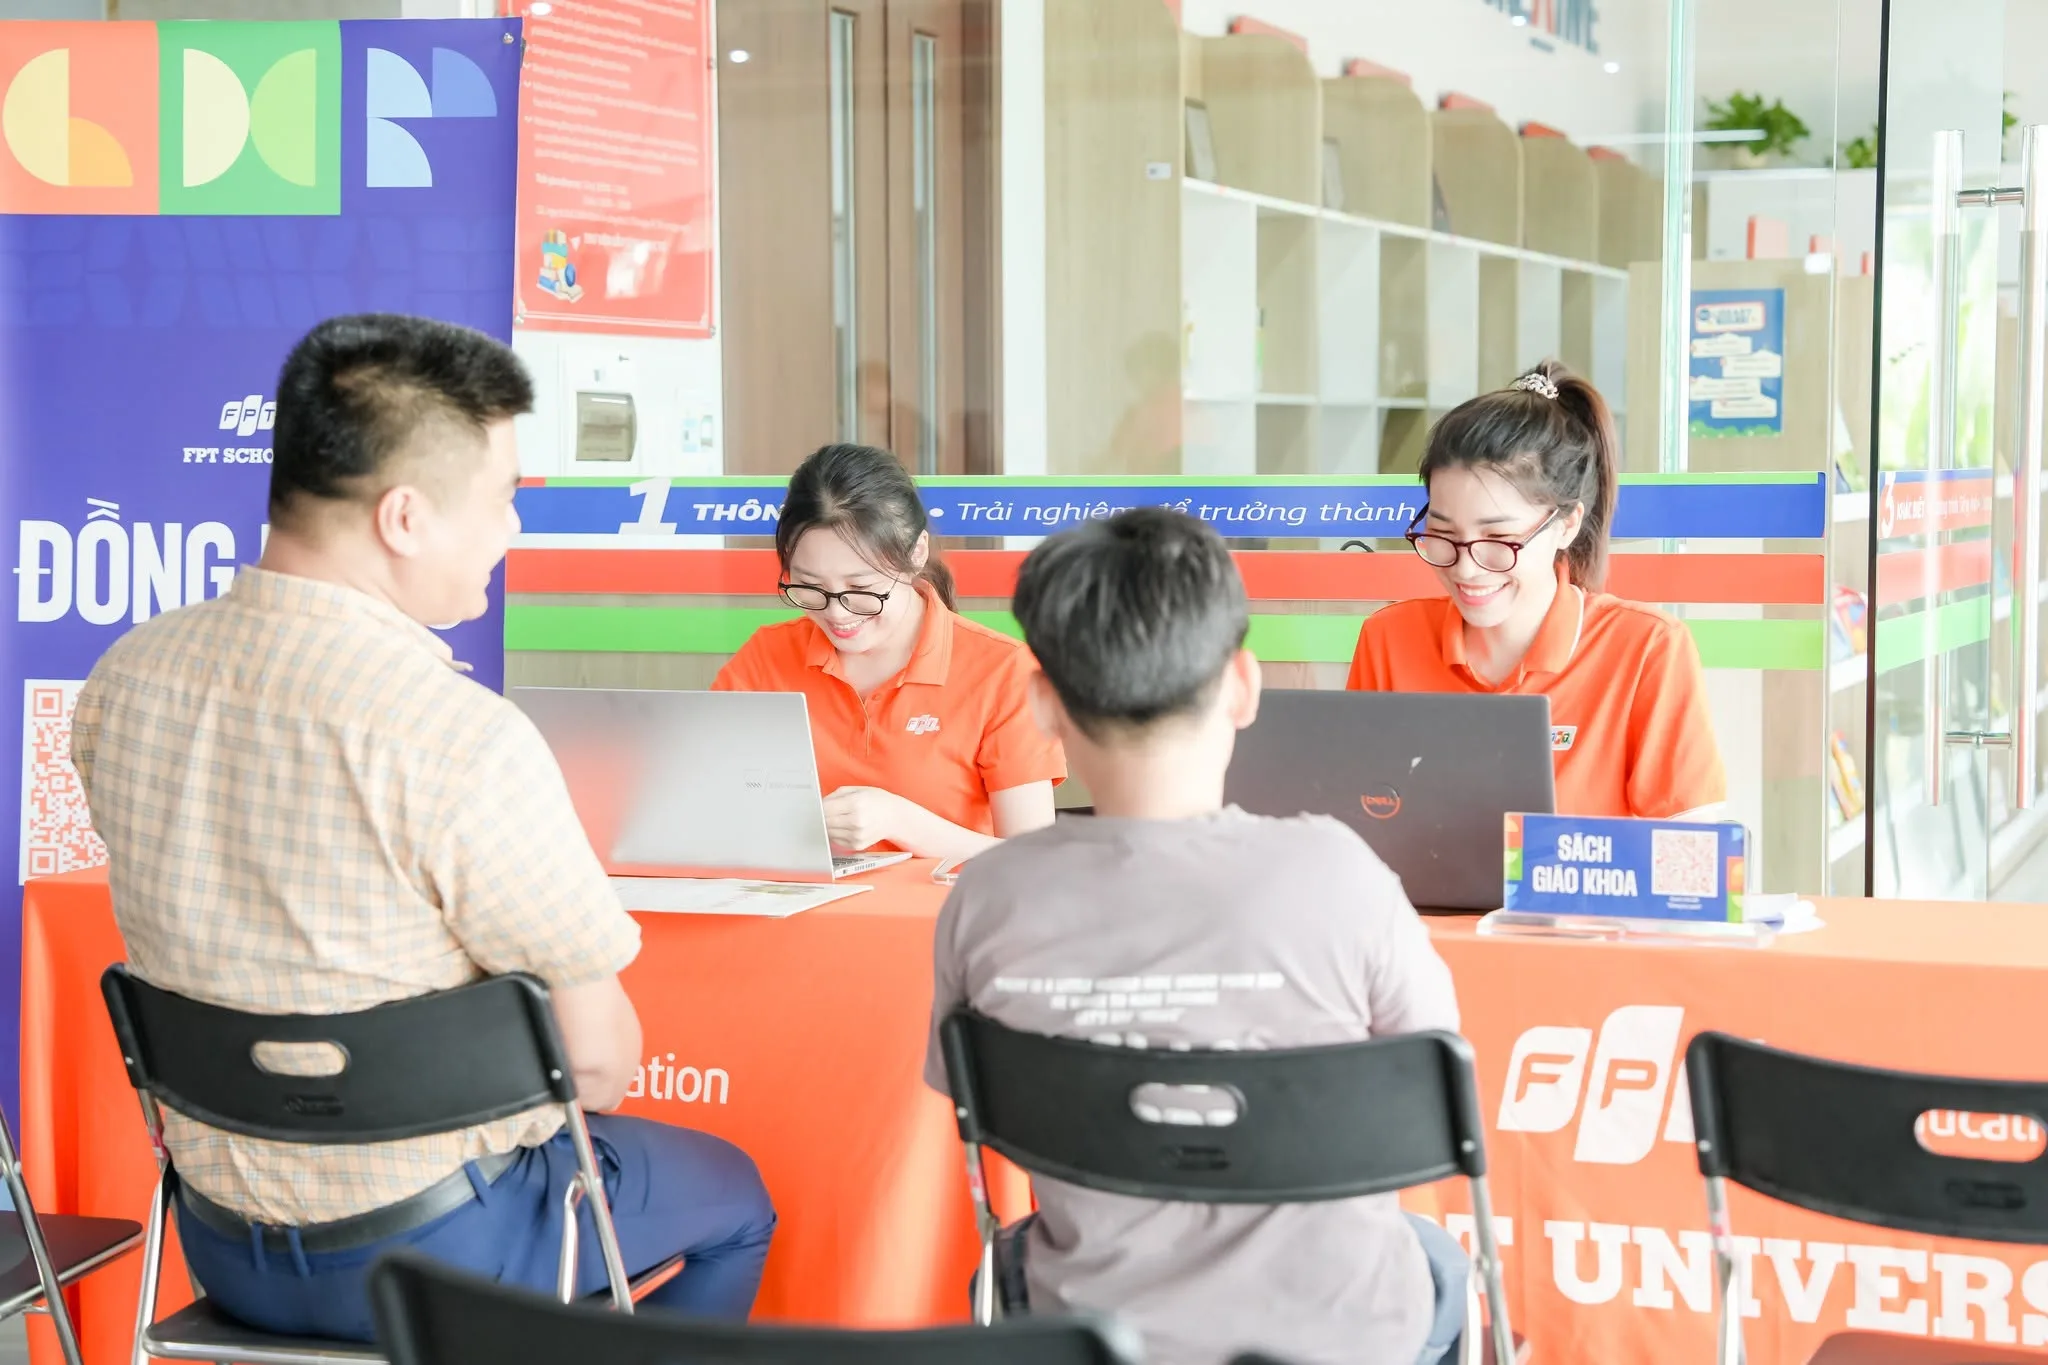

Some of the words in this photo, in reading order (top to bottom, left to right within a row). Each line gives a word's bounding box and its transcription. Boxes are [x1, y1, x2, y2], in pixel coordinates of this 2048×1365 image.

[219, 394, 276, 436] FPT
[183, 447, 219, 463] FPT
[223, 447, 274, 464] SCHO
[618, 476, 678, 535] 1
[693, 499, 785, 521] THÔN
[957, 501, 1014, 521] Trải
[1199, 501, 1307, 526] trưởng
[1320, 502, 1416, 521] thành
[13, 497, 236, 626] ĐỒNG
[1558, 832, 1613, 863] SÁCH
[1532, 864, 1579, 893] GIÁO
[1583, 868, 1638, 897] KHOA
[626, 1053, 729, 1104] ation
[1497, 1005, 1697, 1165] FP
